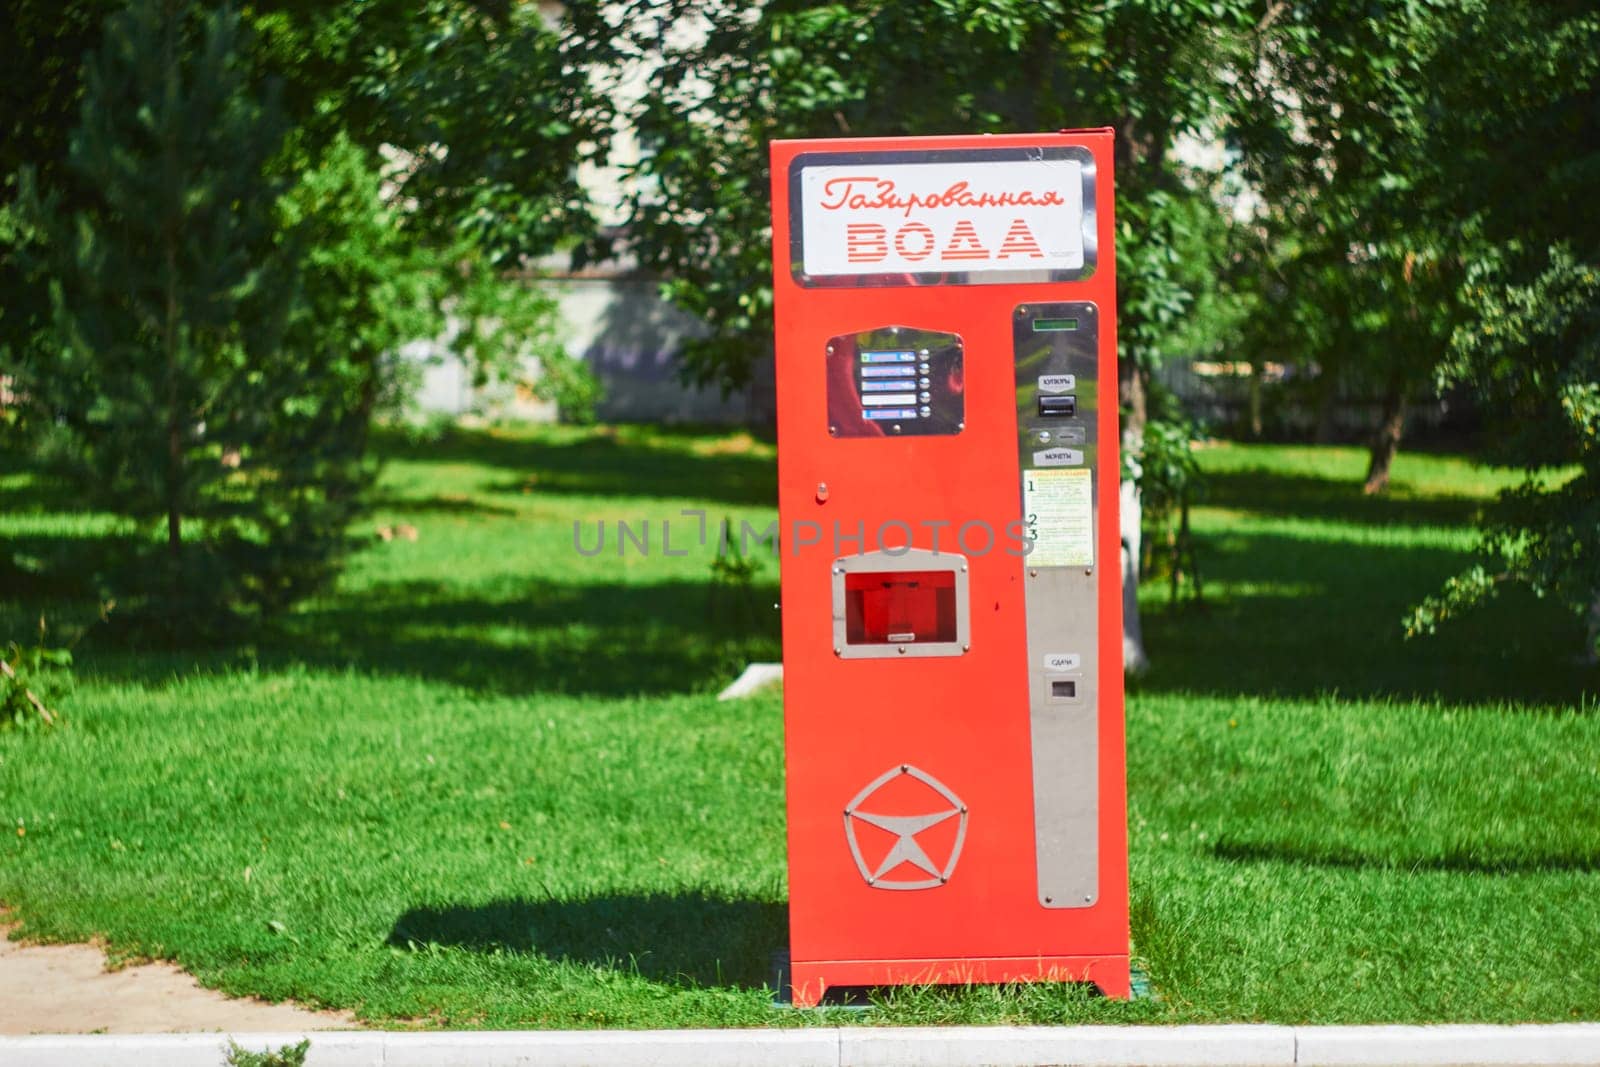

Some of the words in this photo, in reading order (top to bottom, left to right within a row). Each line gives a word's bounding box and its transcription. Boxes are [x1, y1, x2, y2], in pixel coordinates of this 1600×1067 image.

[820, 177, 1064, 217] Газированная
[847, 219, 1045, 263] ВОДА
[1028, 480, 1035, 492] 1
[1029, 513, 1037, 526] 2
[1029, 529, 1038, 541] 3
